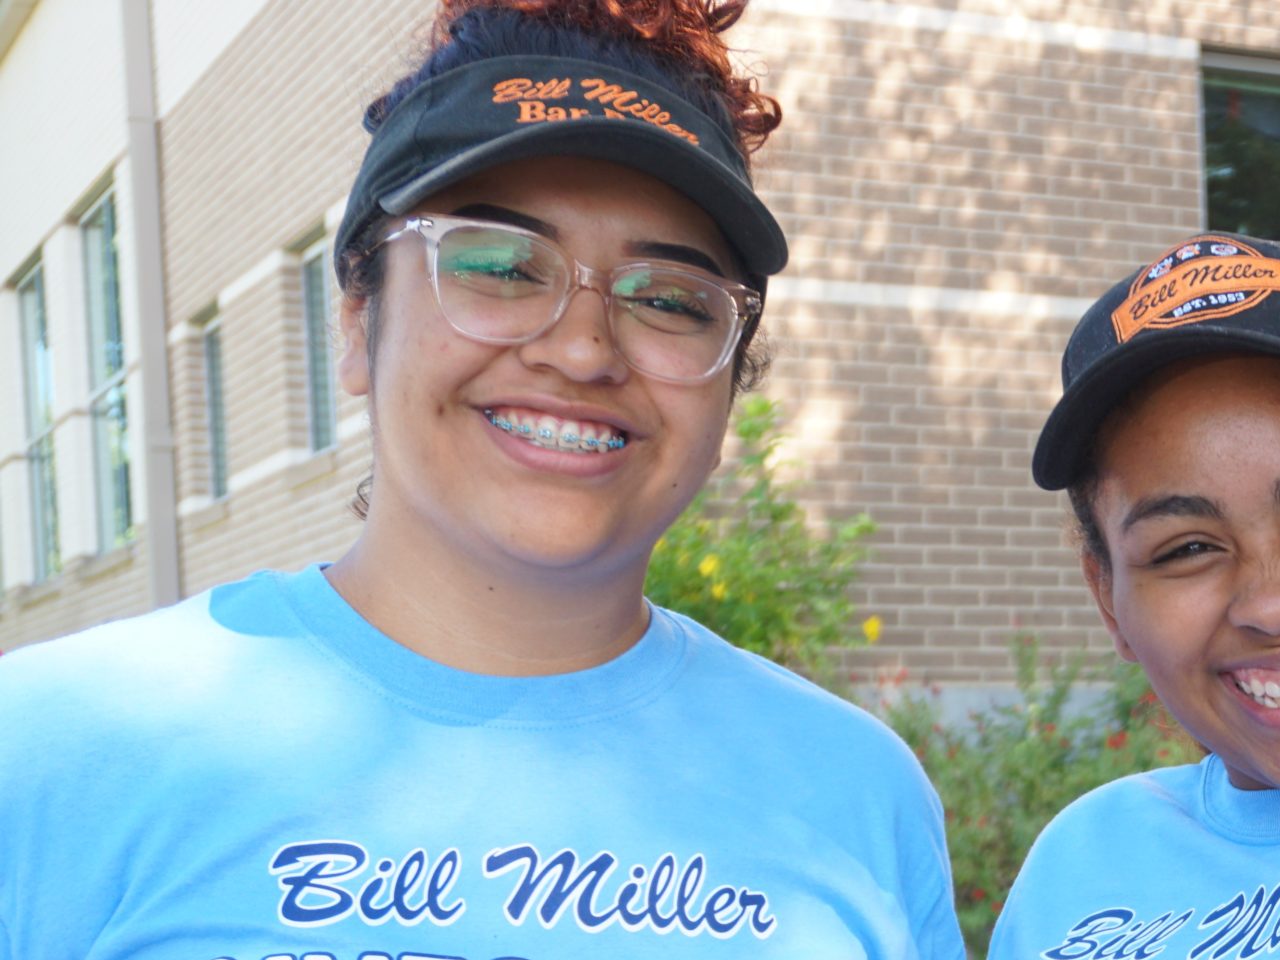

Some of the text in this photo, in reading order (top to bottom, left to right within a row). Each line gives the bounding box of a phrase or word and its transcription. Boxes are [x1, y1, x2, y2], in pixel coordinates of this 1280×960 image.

[492, 77, 700, 146] Bill Miller
[1129, 263, 1278, 321] Bill Miller
[269, 840, 777, 939] Bill Miller
